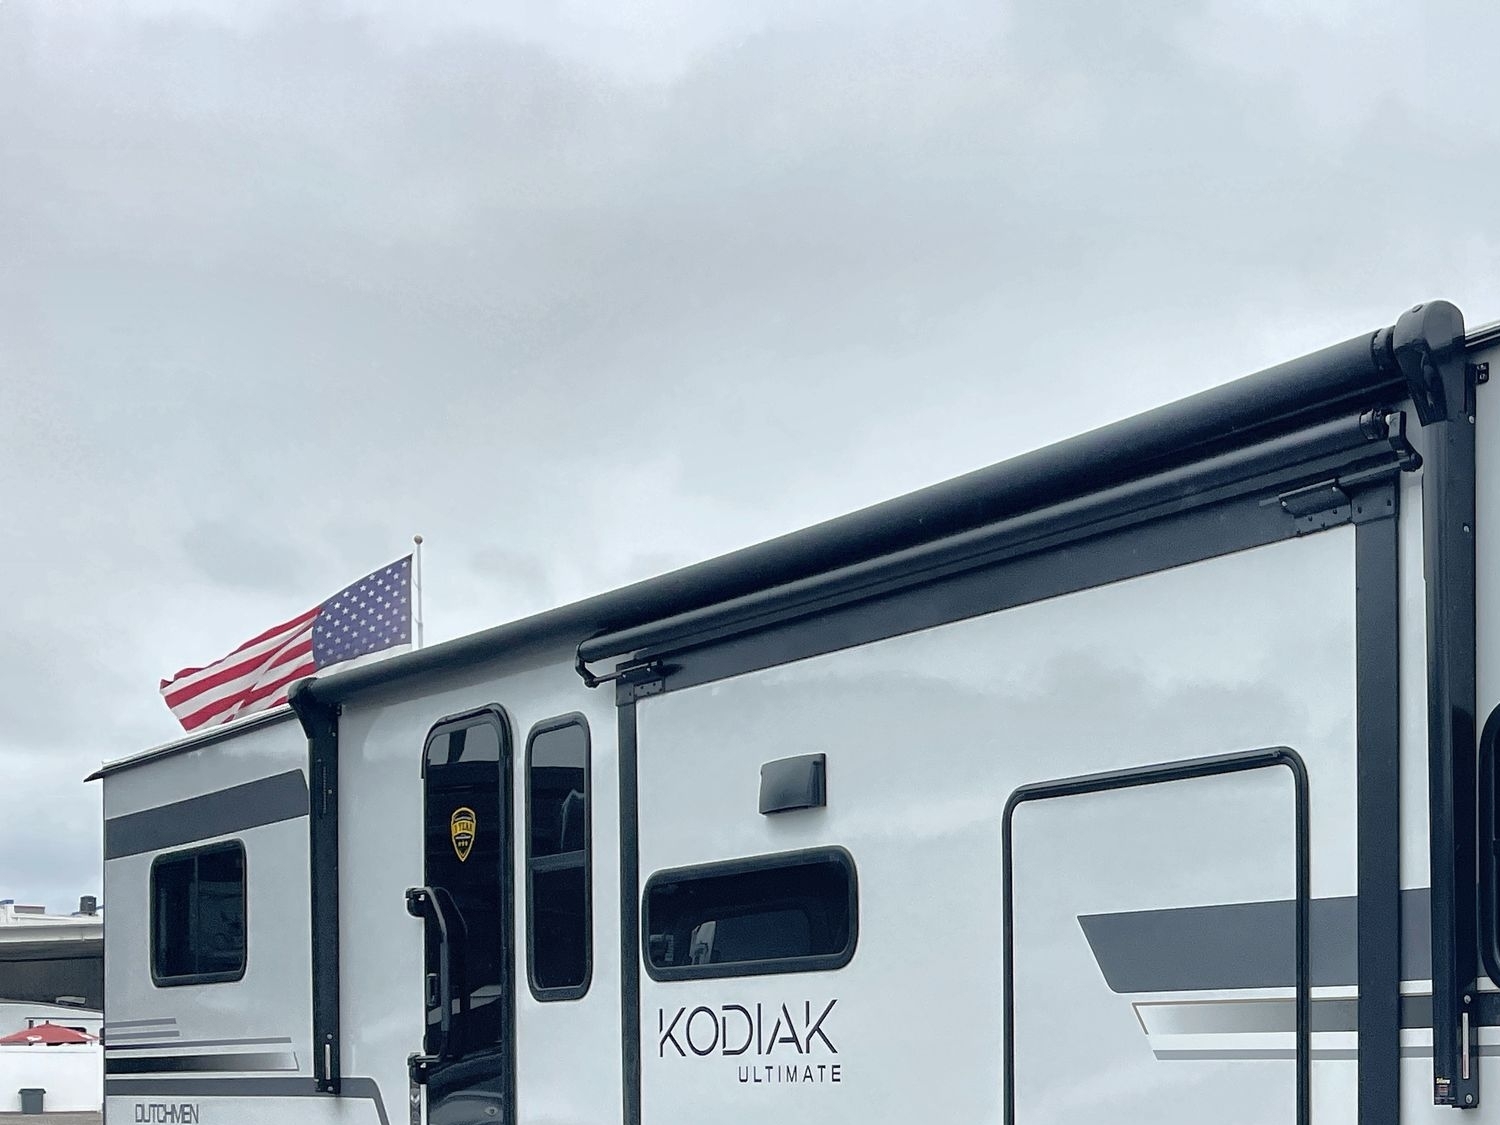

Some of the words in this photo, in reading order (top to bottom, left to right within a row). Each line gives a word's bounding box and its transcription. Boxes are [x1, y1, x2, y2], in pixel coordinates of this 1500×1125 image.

[659, 999, 839, 1058] KODIAK
[738, 1064, 841, 1083] ULTIMATE
[135, 1103, 199, 1124] DUTCHMEN
